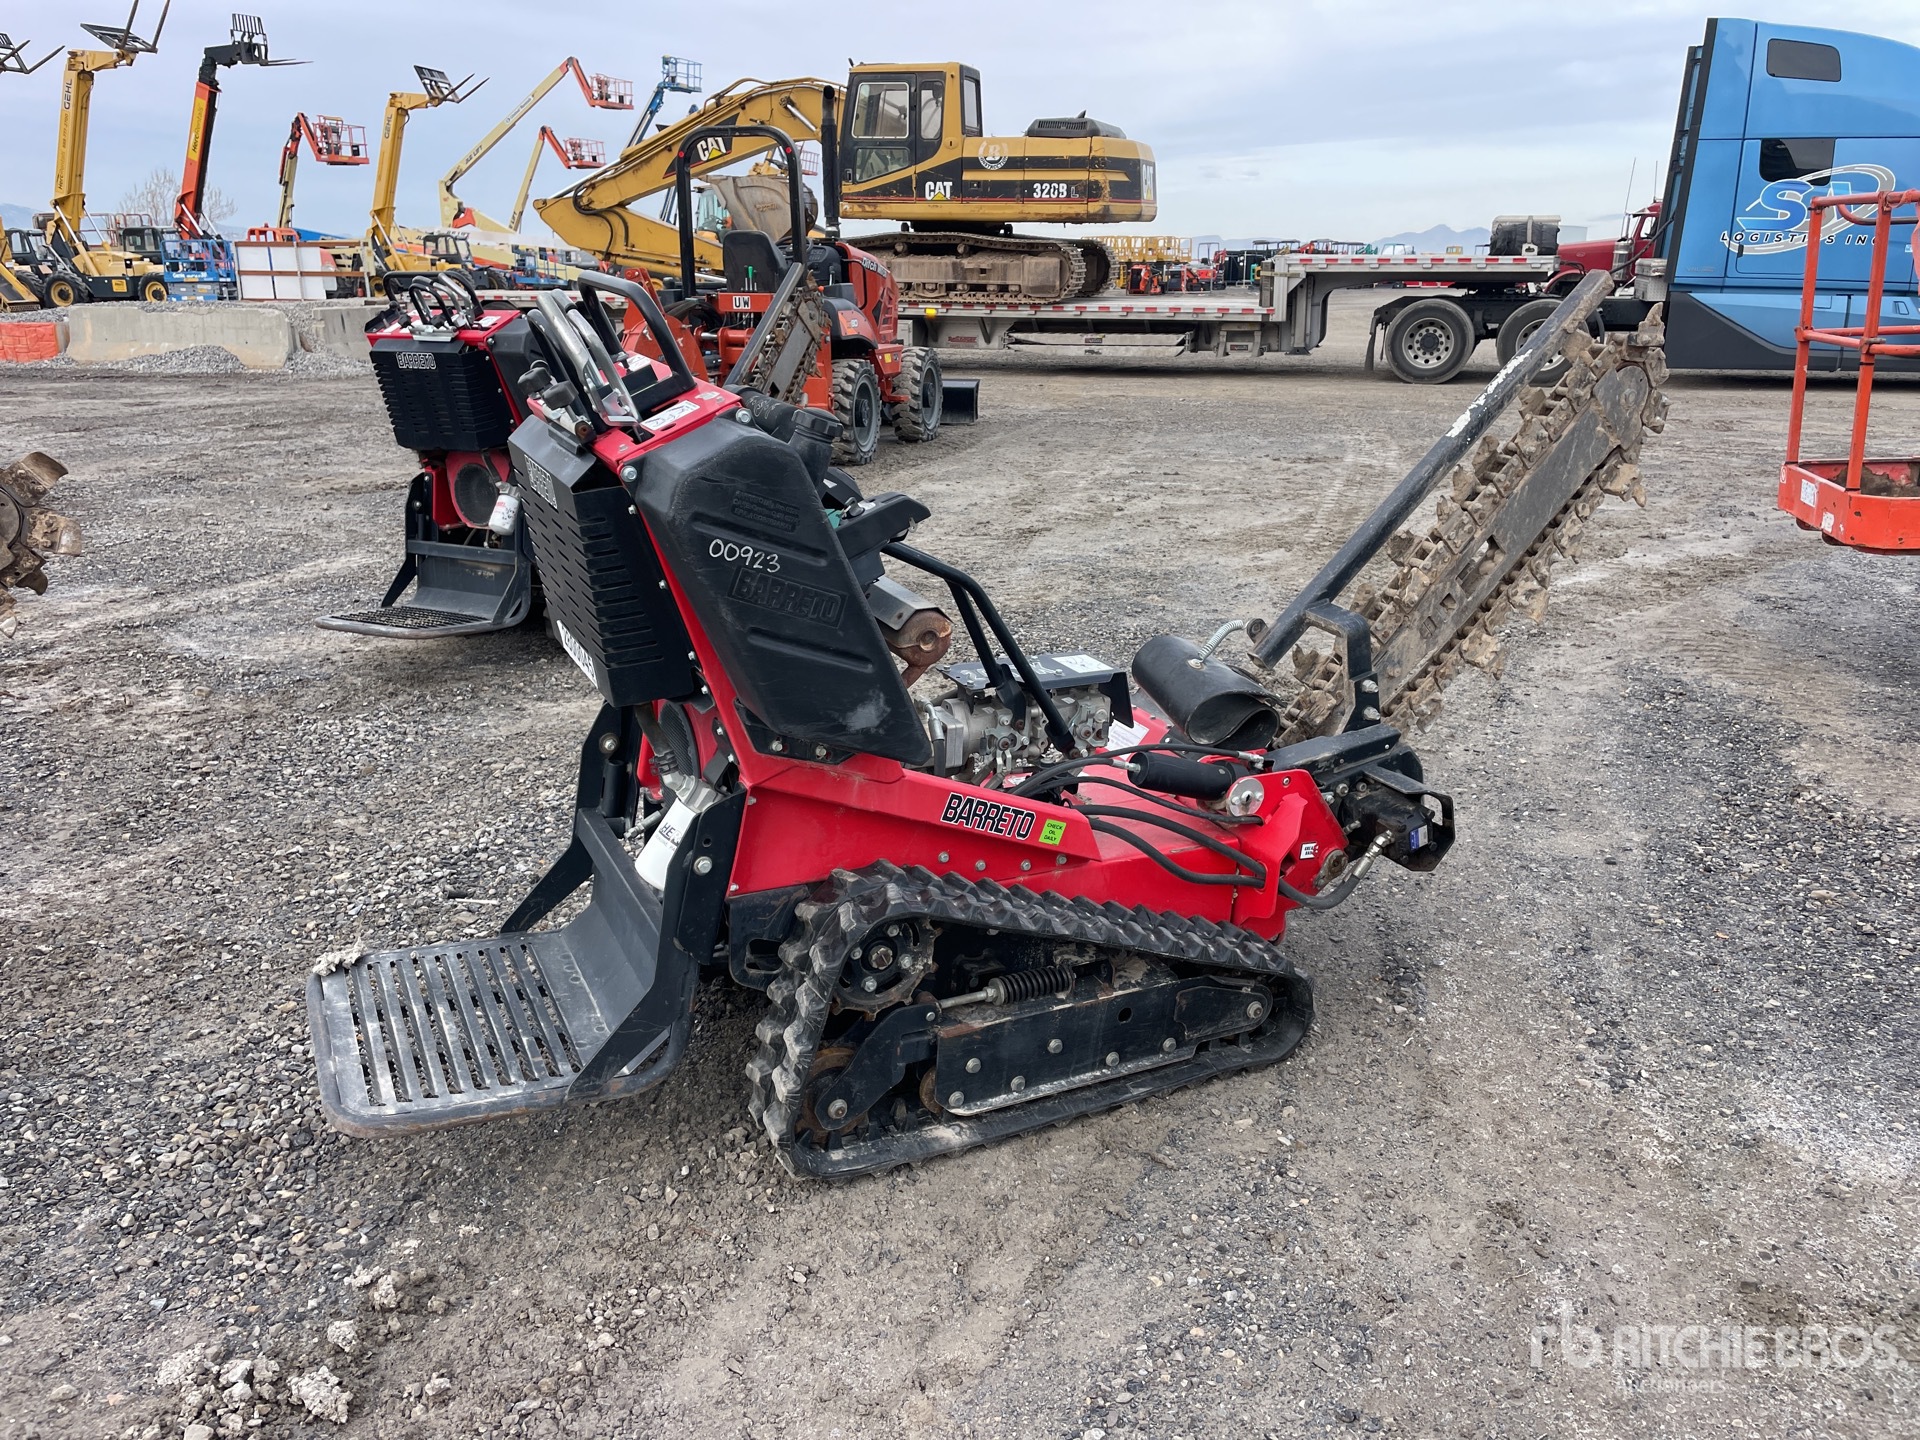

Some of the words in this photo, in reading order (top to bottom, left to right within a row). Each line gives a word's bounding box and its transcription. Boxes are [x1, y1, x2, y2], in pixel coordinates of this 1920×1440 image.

[63, 79, 73, 110] GEHL
[384, 114, 393, 139] GEHL
[696, 137, 727, 162] CAT
[925, 181, 953, 201] CAT
[1033, 183, 1068, 199] 320B
[1142, 164, 1154, 200] CAT
[1720, 231, 1836, 246] LOGISTIS
[733, 296, 750, 308] UW
[396, 352, 437, 370] BARRETO
[708, 538, 781, 573] 00923
[732, 567, 843, 625] BARRETO
[940, 792, 1037, 841] BARRETO
